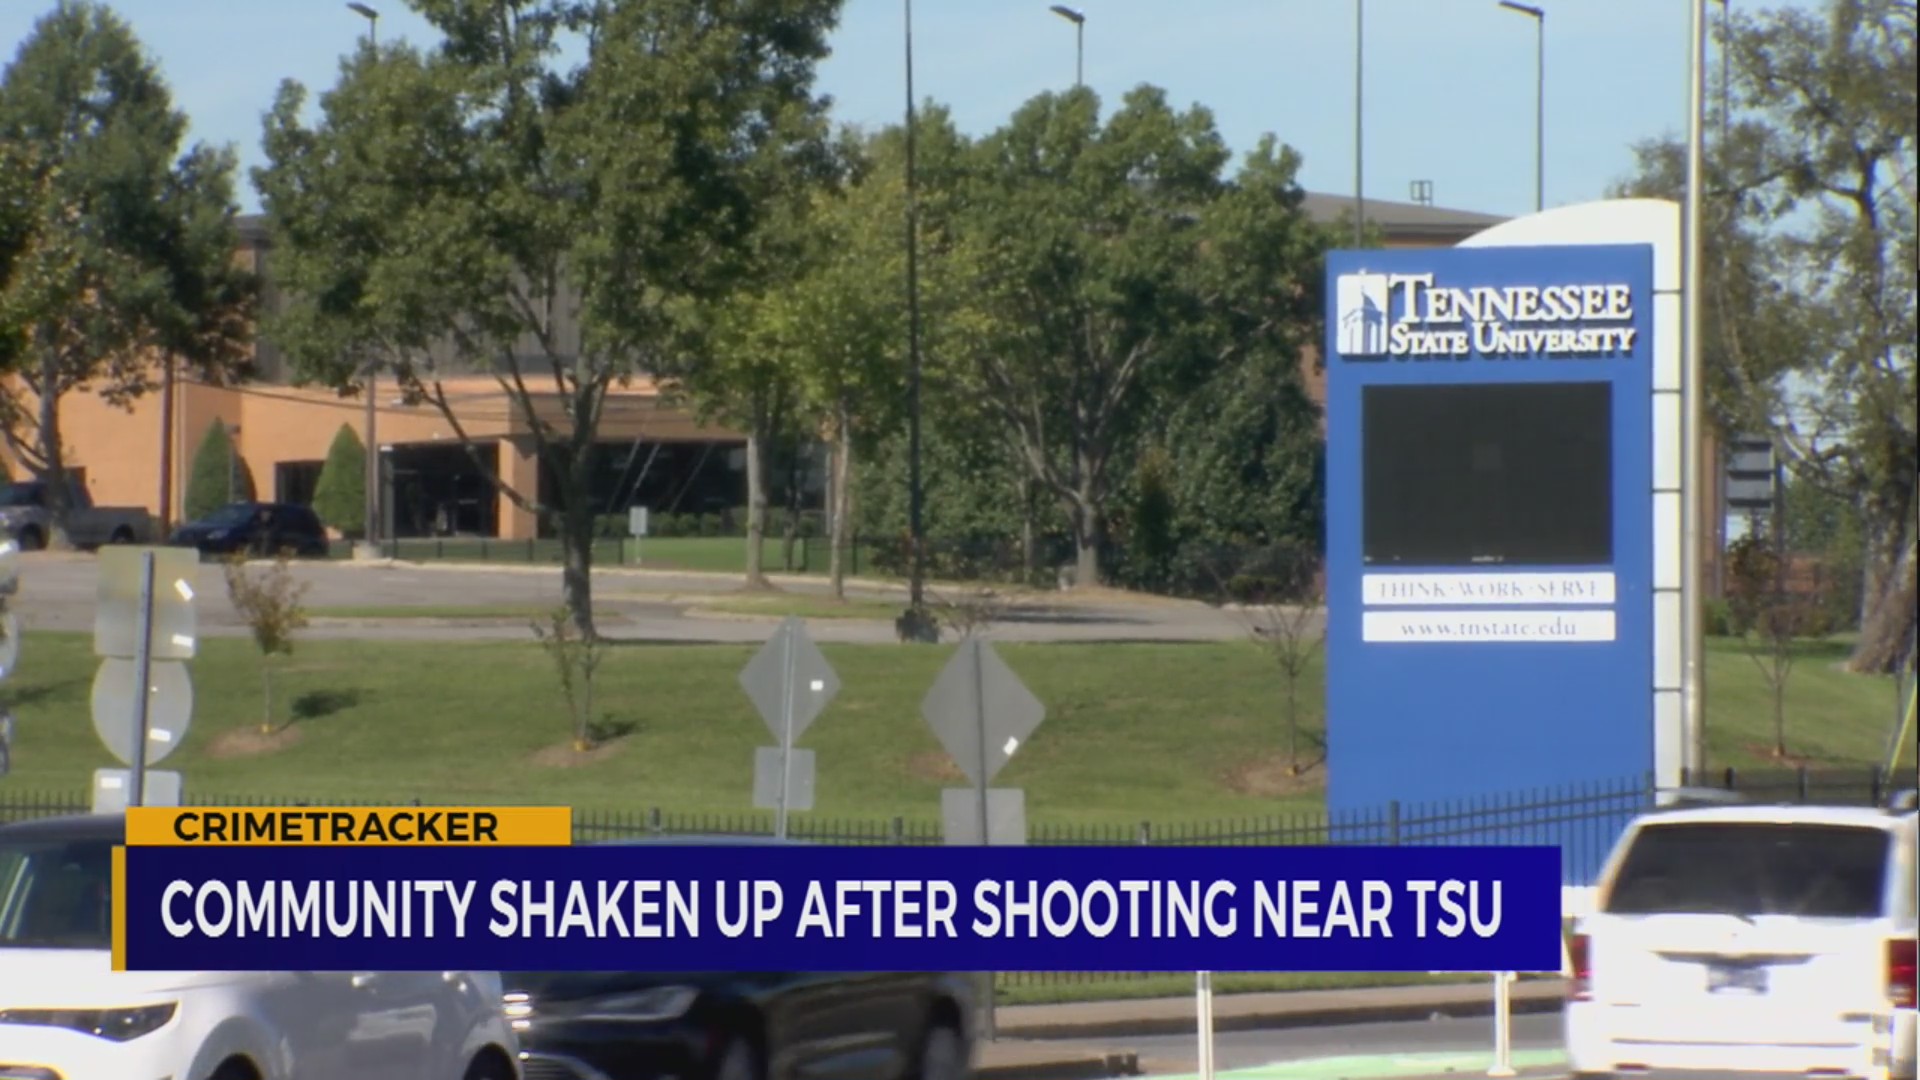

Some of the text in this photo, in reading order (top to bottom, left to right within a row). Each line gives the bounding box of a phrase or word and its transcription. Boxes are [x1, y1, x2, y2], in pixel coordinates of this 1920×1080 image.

[1389, 273, 1633, 323] TENNESSEE
[1389, 321, 1636, 355] STATE UNIVERSITY
[1401, 616, 1577, 636] www.tnstate.edu
